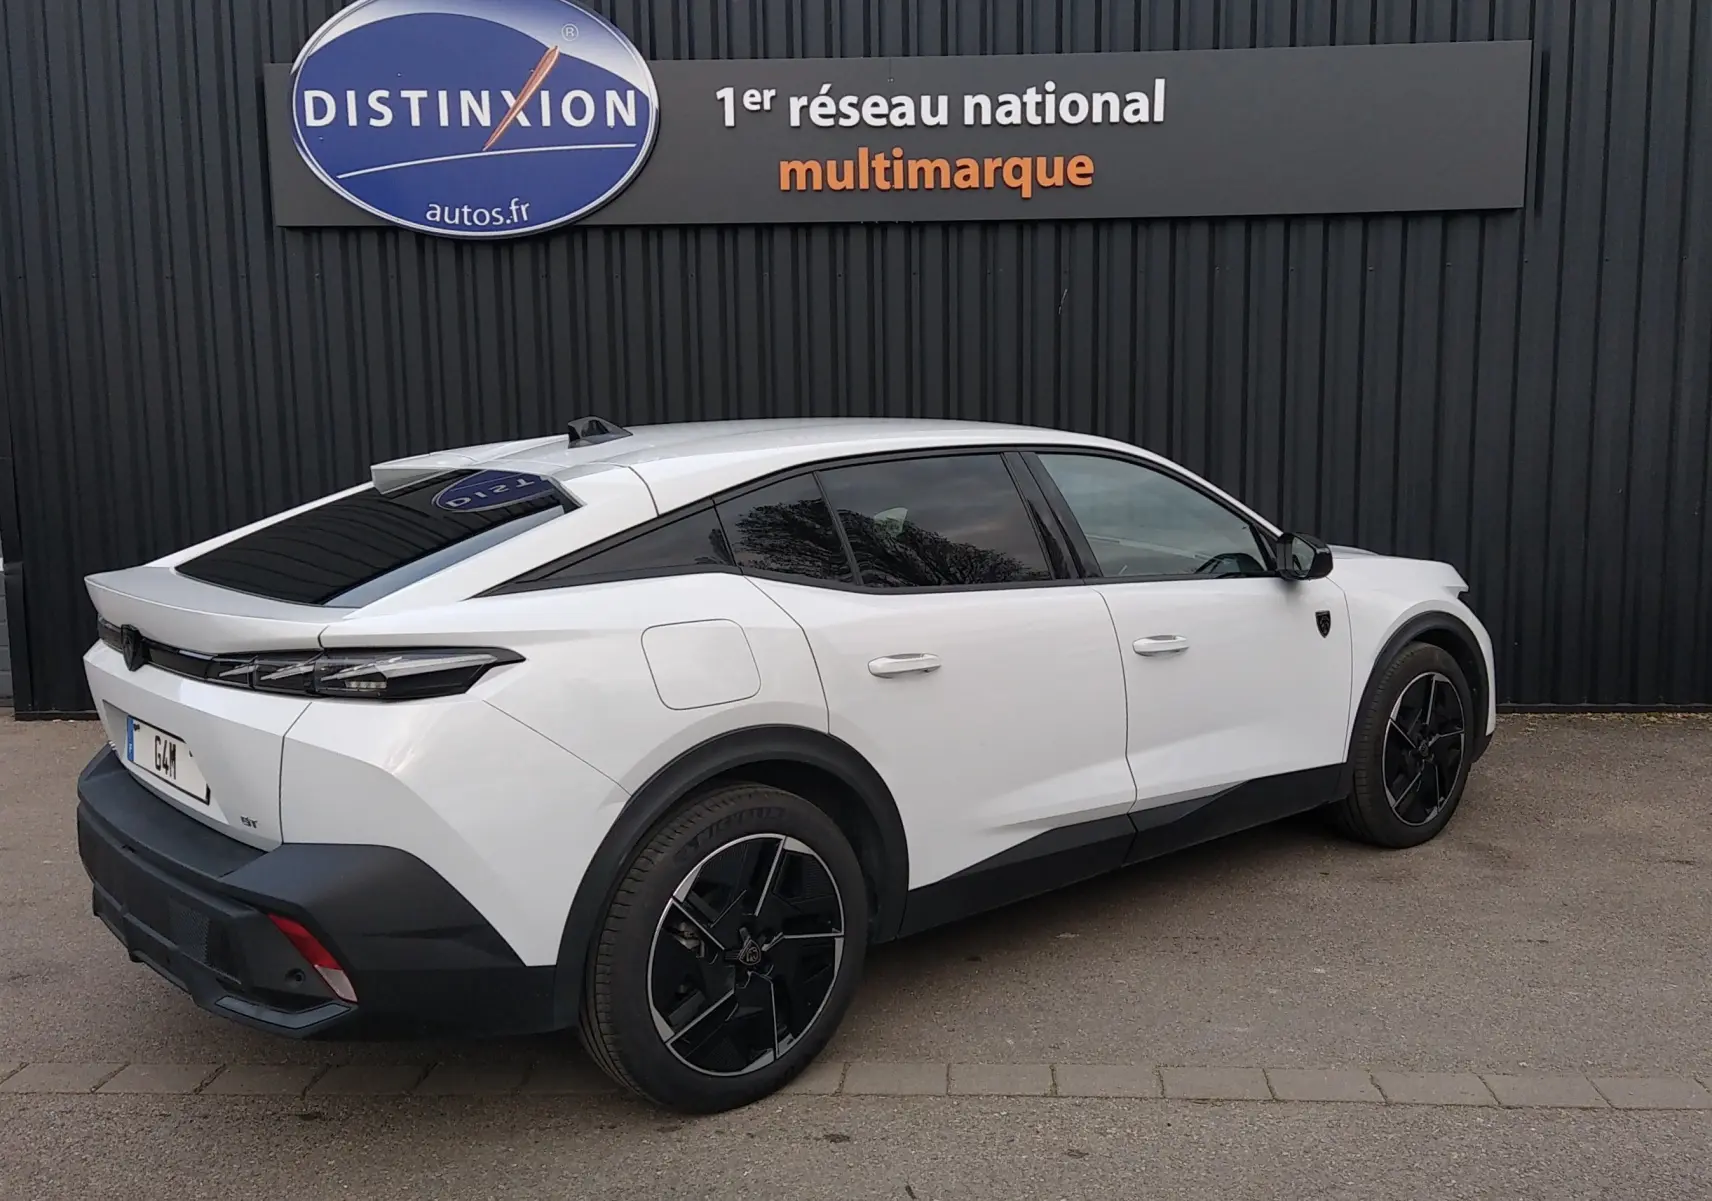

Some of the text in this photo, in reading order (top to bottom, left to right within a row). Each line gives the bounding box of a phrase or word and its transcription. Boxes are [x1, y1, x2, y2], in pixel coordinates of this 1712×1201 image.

[303, 89, 637, 127] DISTINXION
[789, 83, 948, 127] réseau
[963, 78, 1166, 126] national
[779, 147, 1095, 198] multimarque
[425, 198, 530, 226] autos.fr
[155, 736, 176, 779] G4M
